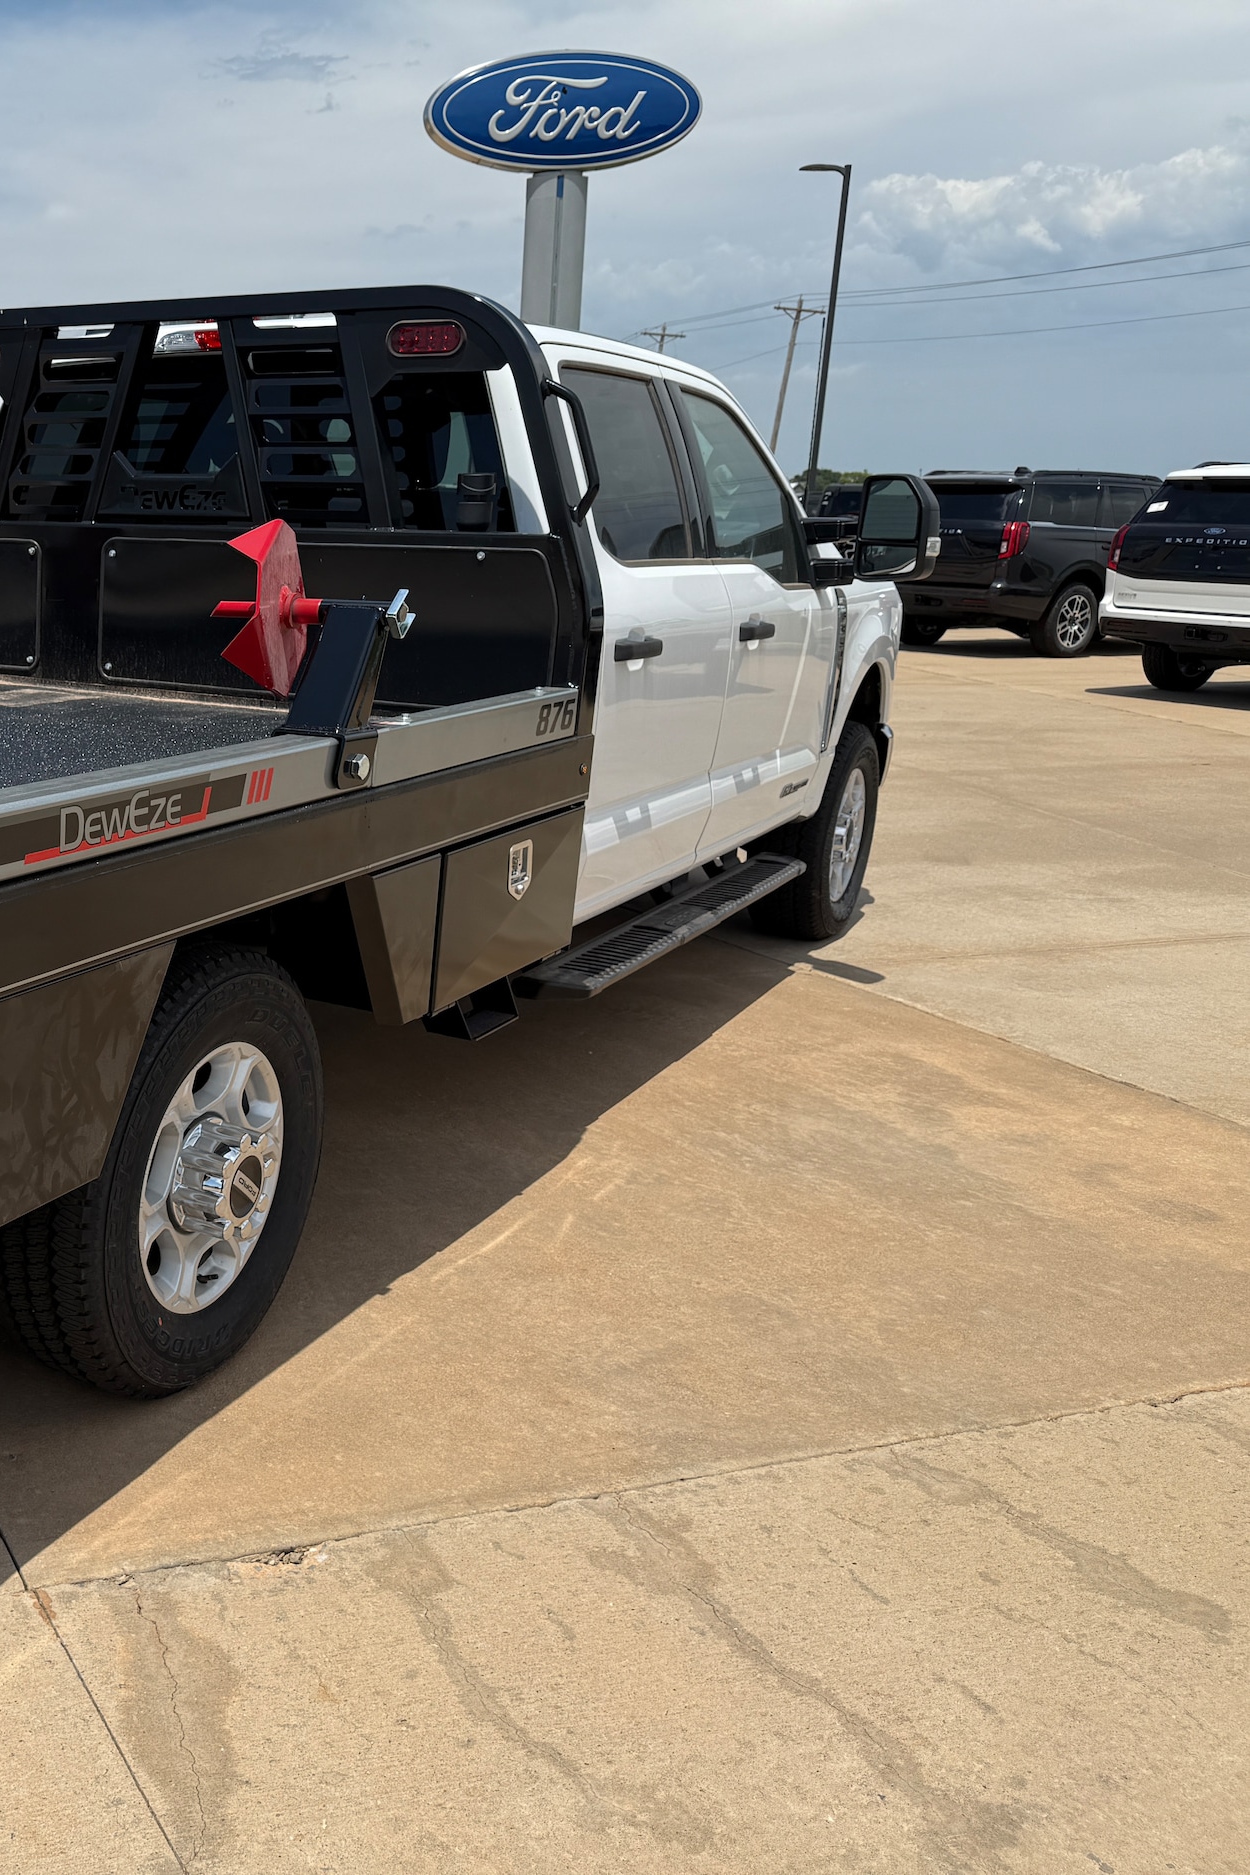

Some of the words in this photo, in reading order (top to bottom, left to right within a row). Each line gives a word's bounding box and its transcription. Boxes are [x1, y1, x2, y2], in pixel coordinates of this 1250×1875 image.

[488, 75, 647, 142] Ford
[536, 698, 576, 737] 876
[238, 1177, 257, 1197] FORD
